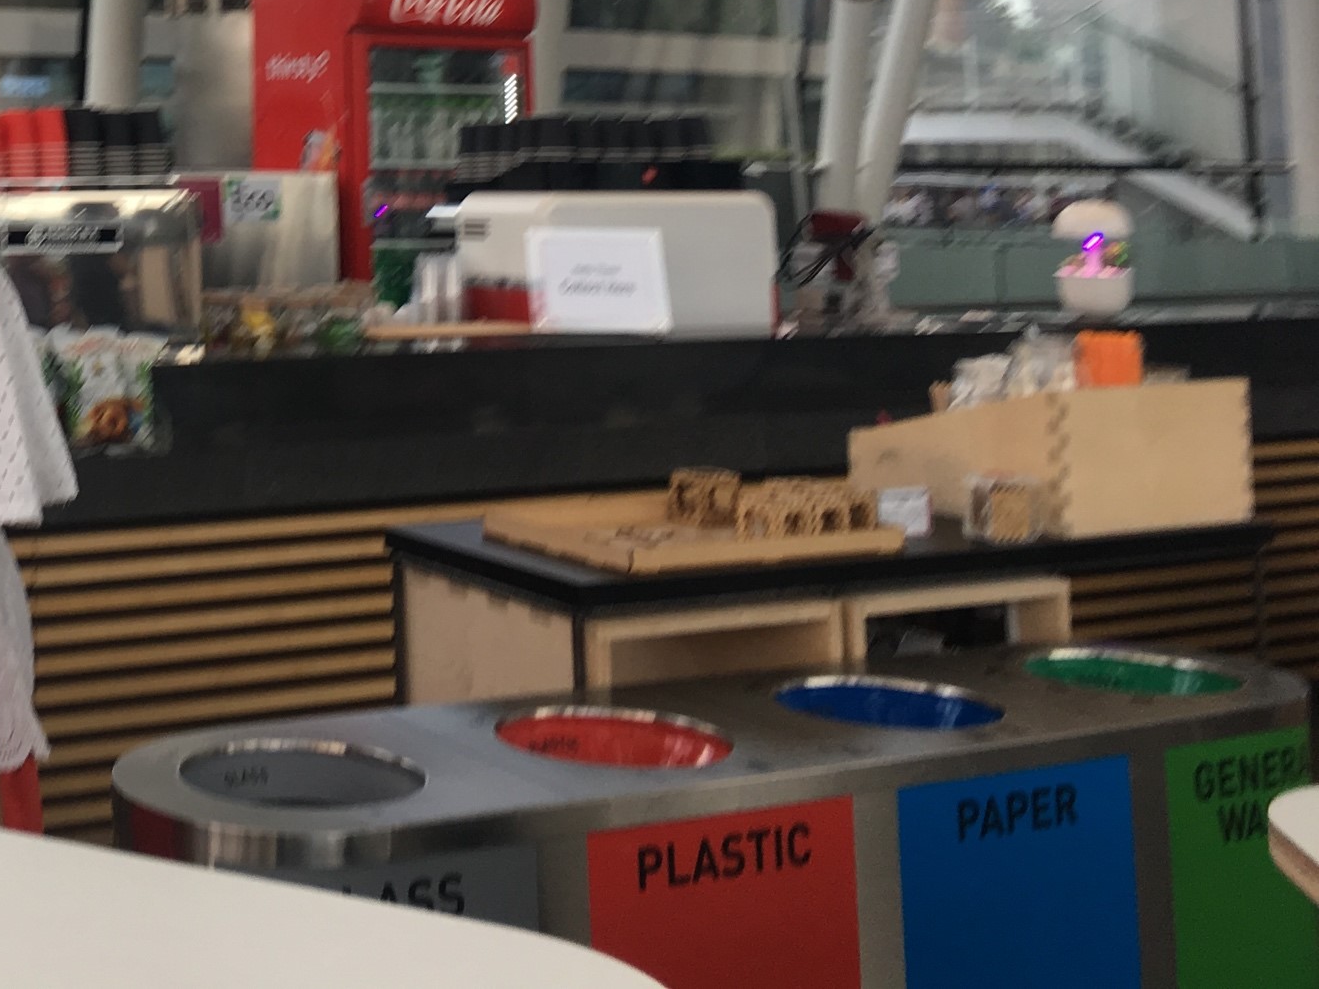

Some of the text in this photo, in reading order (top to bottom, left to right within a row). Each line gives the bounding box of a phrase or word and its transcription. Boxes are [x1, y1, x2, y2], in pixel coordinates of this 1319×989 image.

[1194, 746, 1306, 803] GENER
[957, 784, 1077, 841] PAPER
[637, 822, 812, 891] PLASTIC
